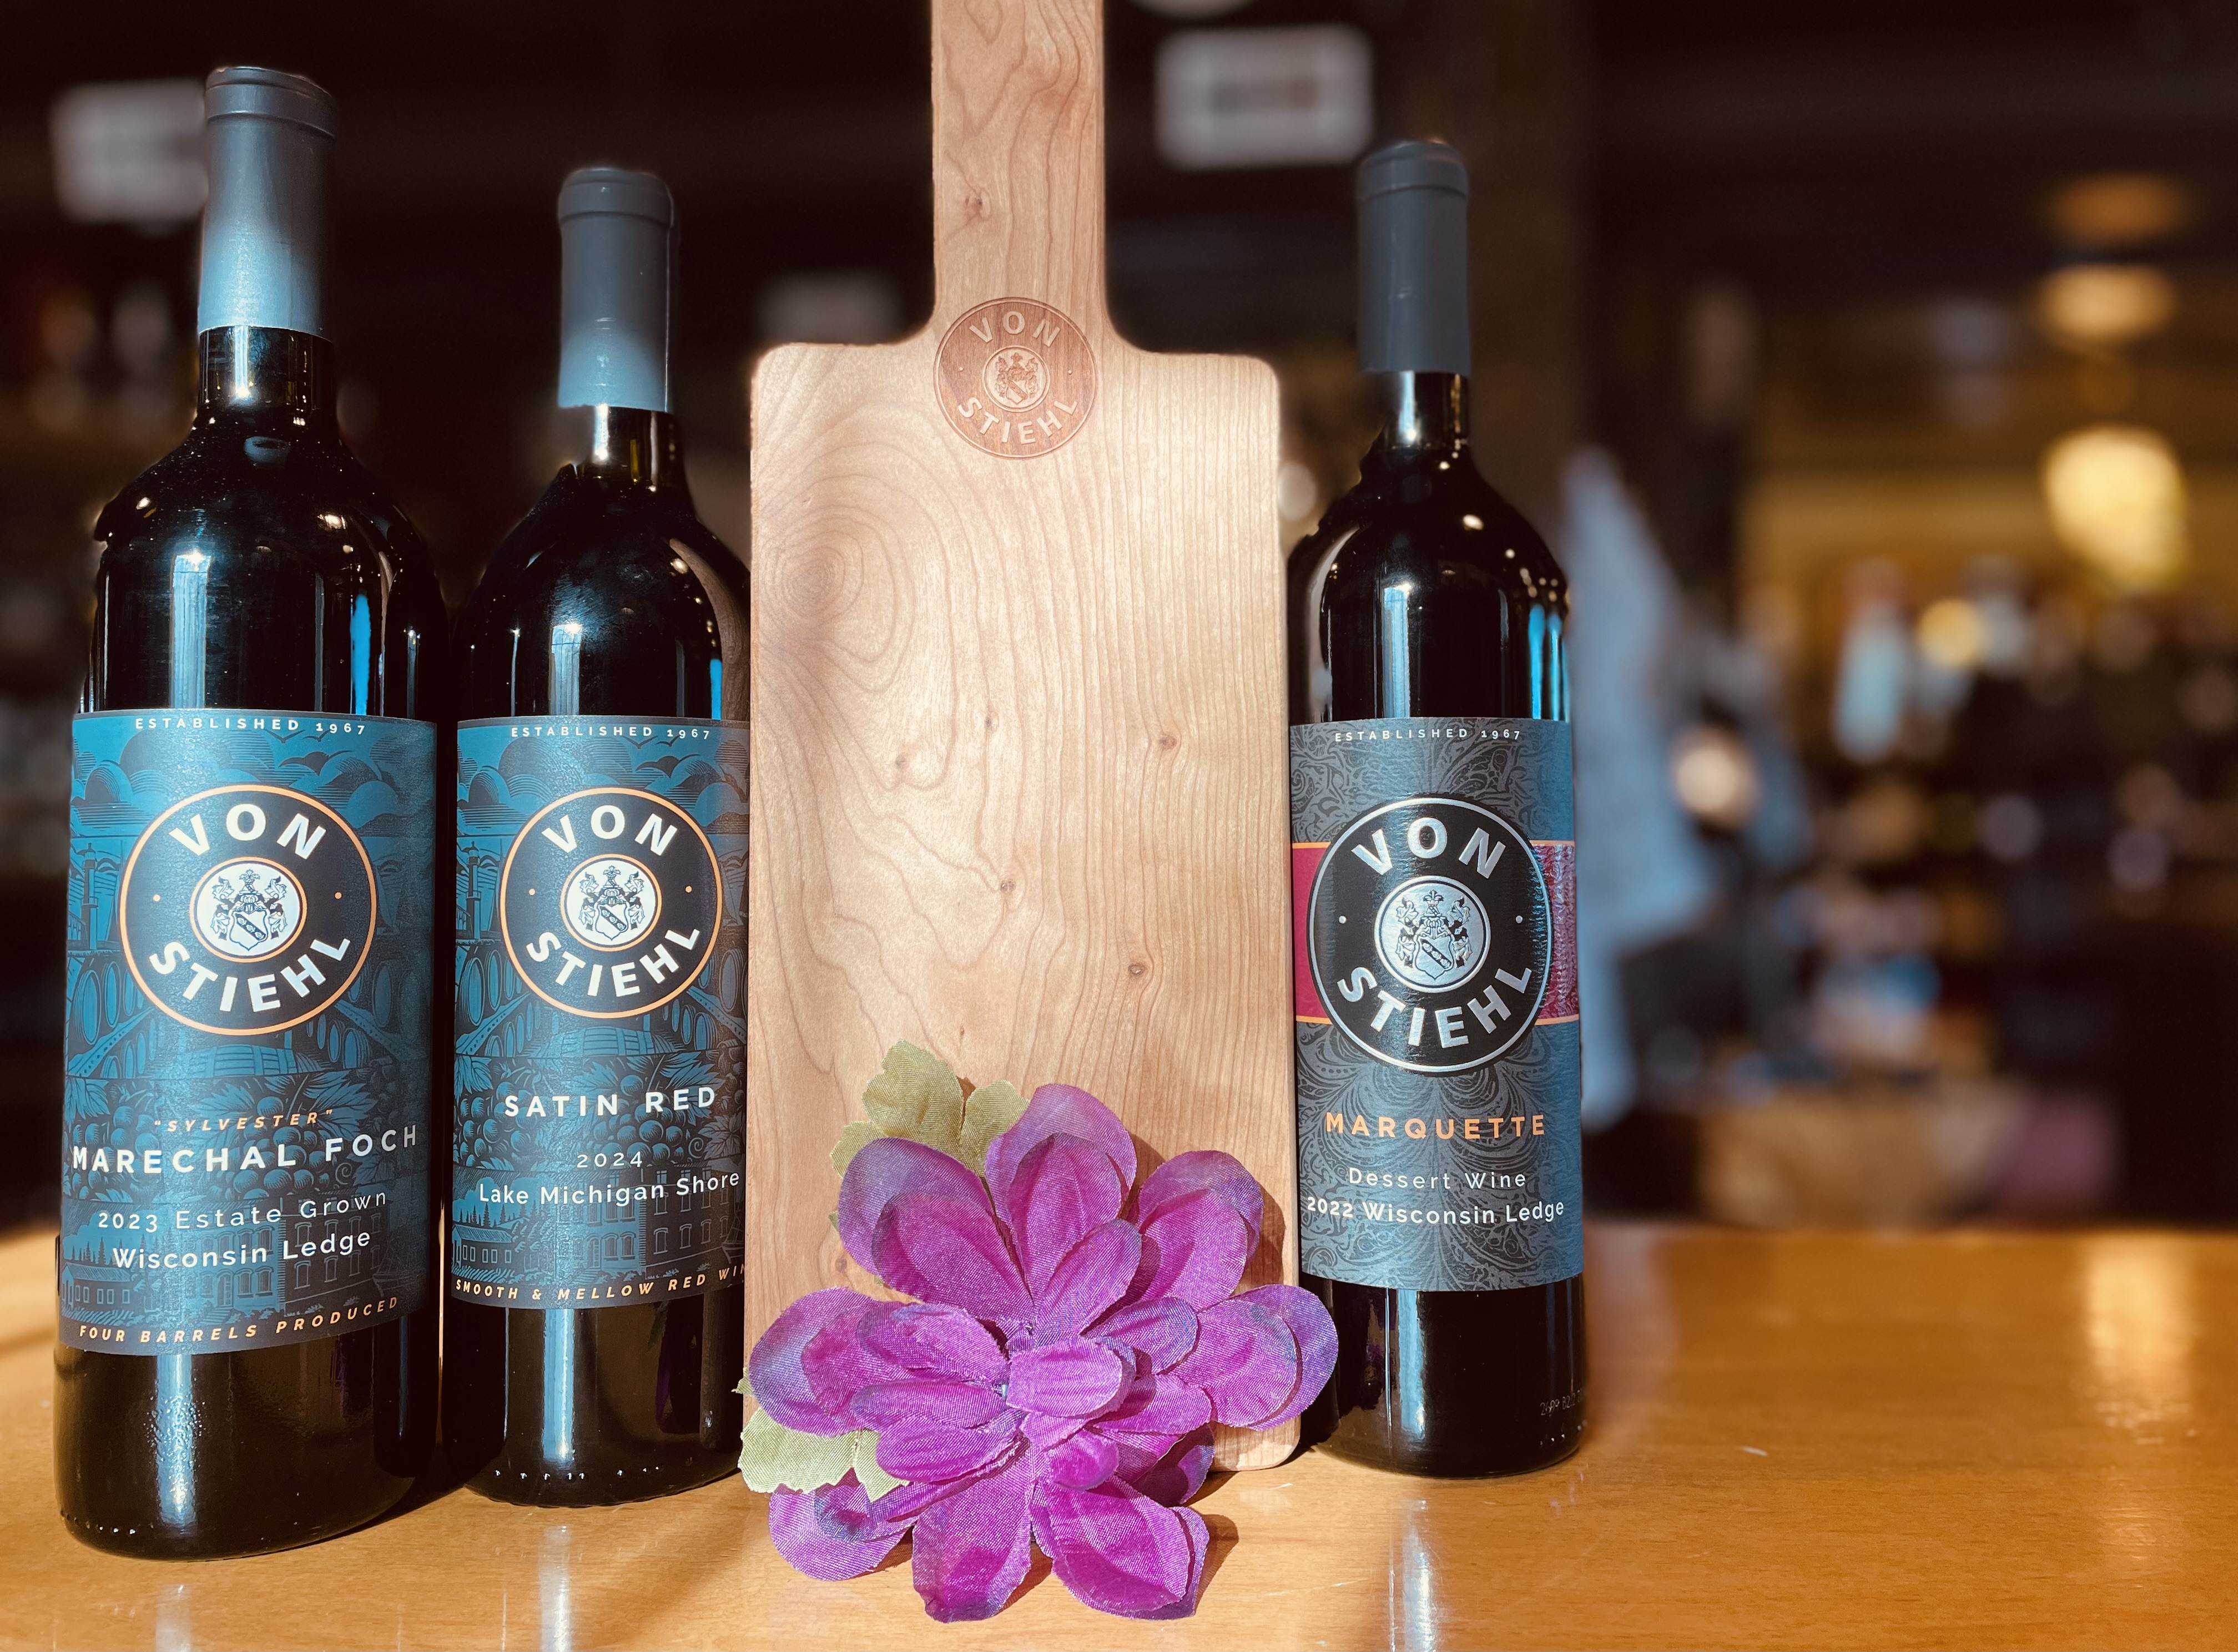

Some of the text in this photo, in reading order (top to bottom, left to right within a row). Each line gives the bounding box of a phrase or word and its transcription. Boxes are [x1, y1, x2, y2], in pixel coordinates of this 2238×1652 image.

[969, 311, 1061, 347] VON
[957, 397, 1078, 445] STIEHL
[135, 717, 366, 735] ESTABLISHED 1967
[511, 726, 711, 740] ESTABLISHED 1967
[1334, 728, 1521, 742] ESTABLISHED 1967
[168, 804, 326, 860] VON
[541, 804, 678, 856] VON
[1350, 817, 1506, 880] VON
[149, 938, 351, 1013] STIEHL
[526, 928, 700, 998] STIEHL
[1337, 966, 1533, 1049] STIEHL
[504, 1087, 716, 1118] SATIN RED
[1325, 1112, 1545, 1140] MARQUETTE
[73, 1124, 417, 1174] MARECHAL FOCH
[576, 1151, 643, 1168] 2024
[479, 1172, 740, 1208] Lake Michigan Shore
[1348, 1166, 1526, 1190] Dessert Wine
[98, 1191, 387, 1234] 2023 Estate Grown
[1307, 1196, 1565, 1225] 2022 Wisconsin Ledge
[112, 1230, 371, 1269] Wisconsin Ledge
[455, 1279, 519, 1300] SMOOTH
[531, 1288, 542, 1301] &
[557, 1282, 655, 1301] MELLOW
[667, 1273, 706, 1292] RED
[79, 1296, 399, 1343] FOUR BARRELS PRODUCED
